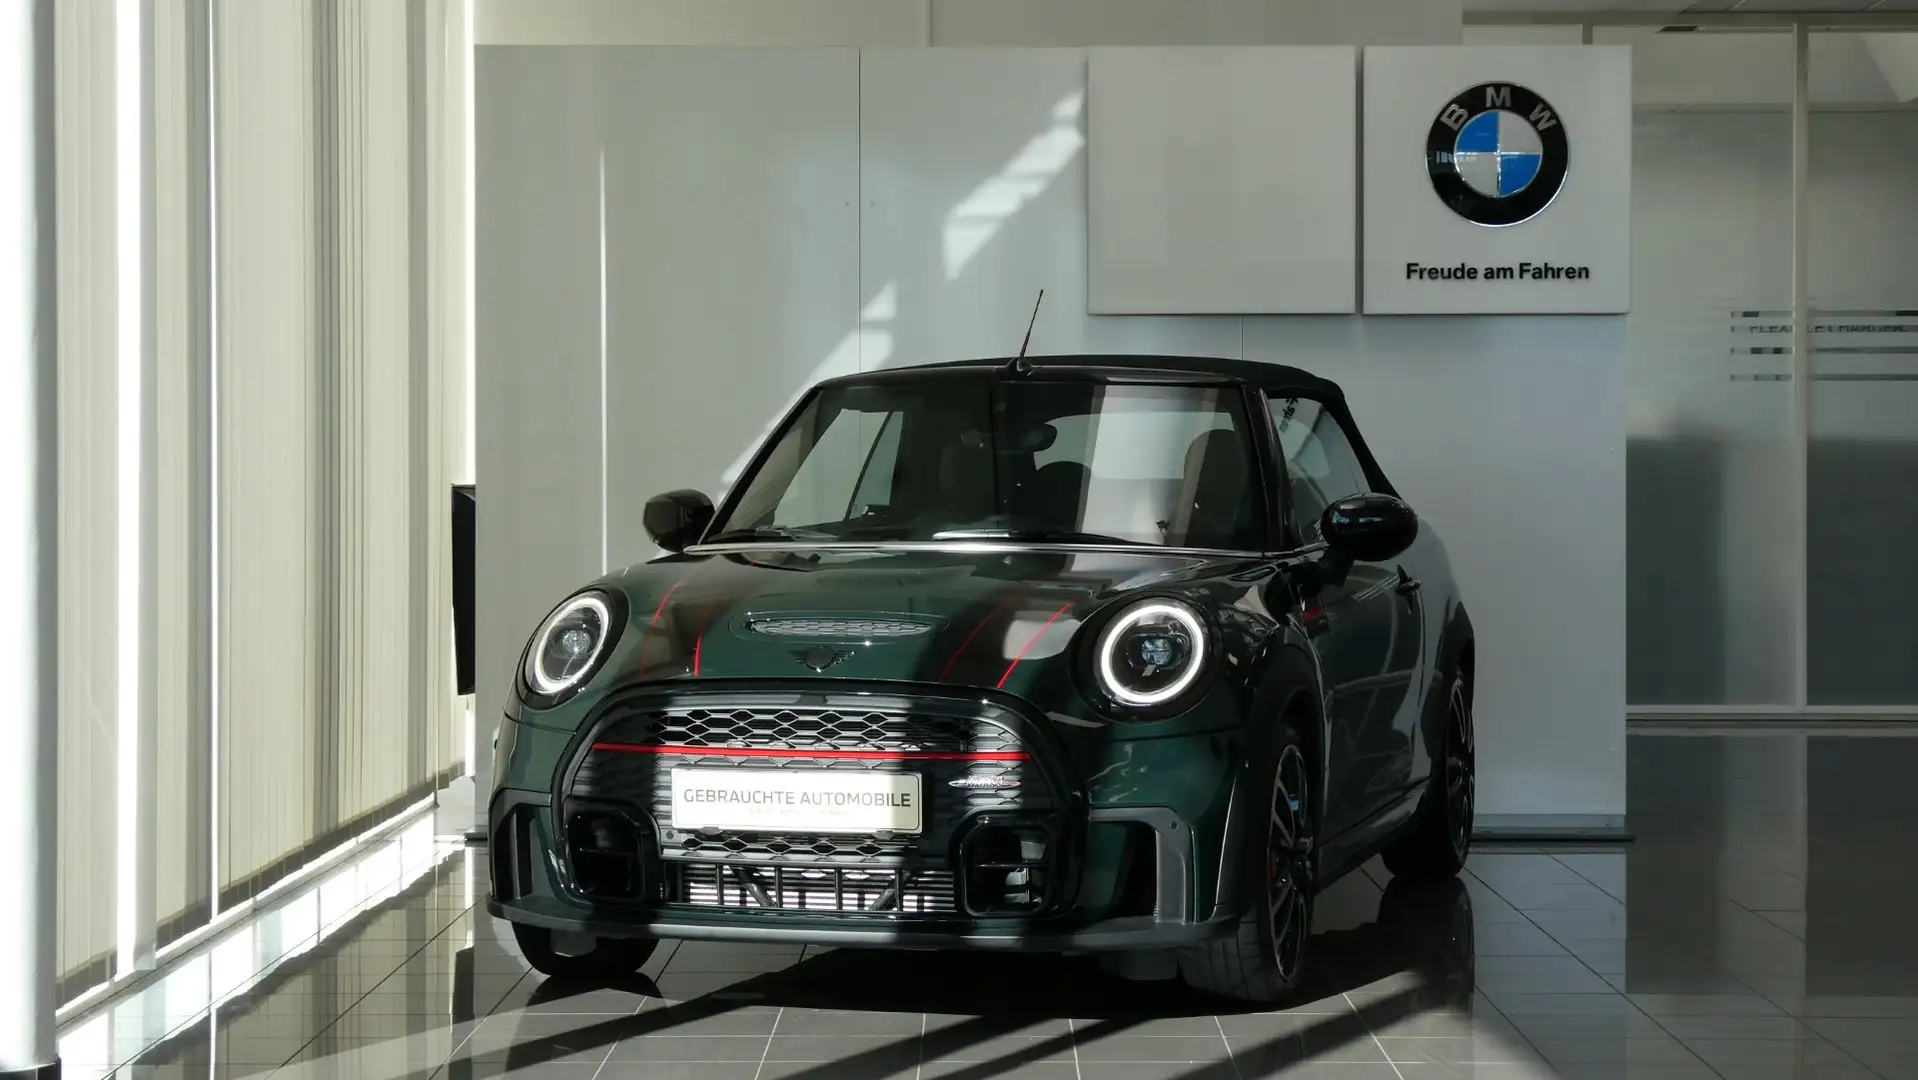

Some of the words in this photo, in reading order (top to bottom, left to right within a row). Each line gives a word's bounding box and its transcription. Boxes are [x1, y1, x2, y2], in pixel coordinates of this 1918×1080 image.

[1440, 86, 1557, 132] BMW
[1406, 262, 1478, 280] Freude
[1483, 266, 1514, 280] am
[1519, 262, 1590, 280] Fahren
[683, 788, 795, 806] GEBRAUCHTE
[800, 791, 912, 808] AUTOMOBILE
